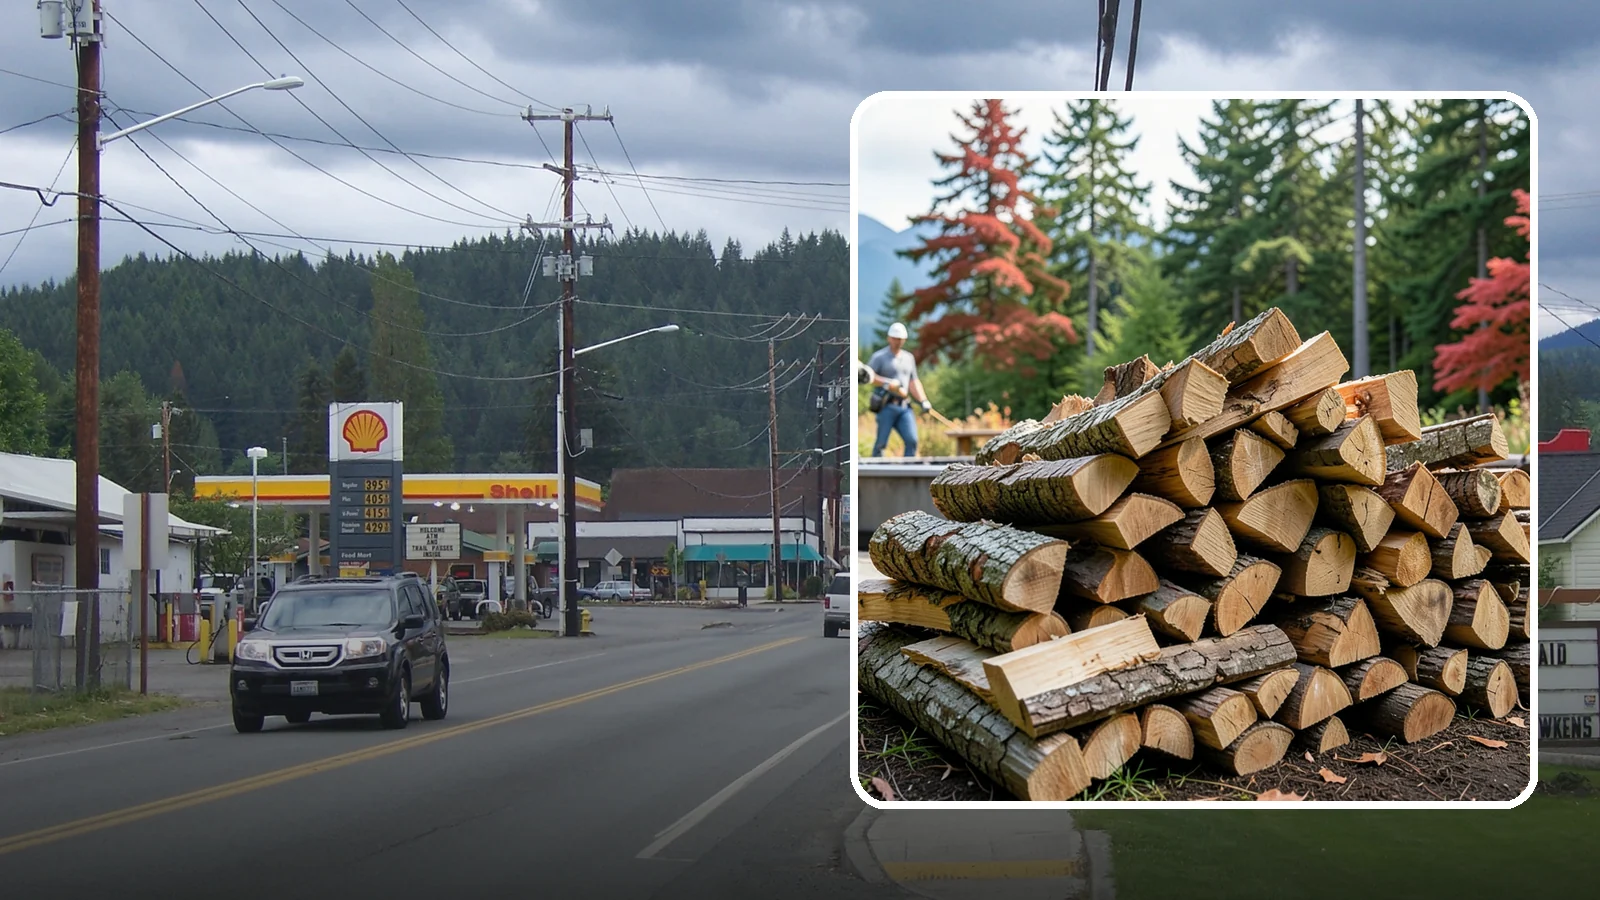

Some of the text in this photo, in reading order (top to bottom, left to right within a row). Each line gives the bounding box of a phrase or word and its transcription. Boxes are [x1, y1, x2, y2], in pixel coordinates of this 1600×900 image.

[490, 484, 547, 499] Shell
[1538, 642, 1567, 666] AID
[1538, 715, 1592, 739] WKENS
